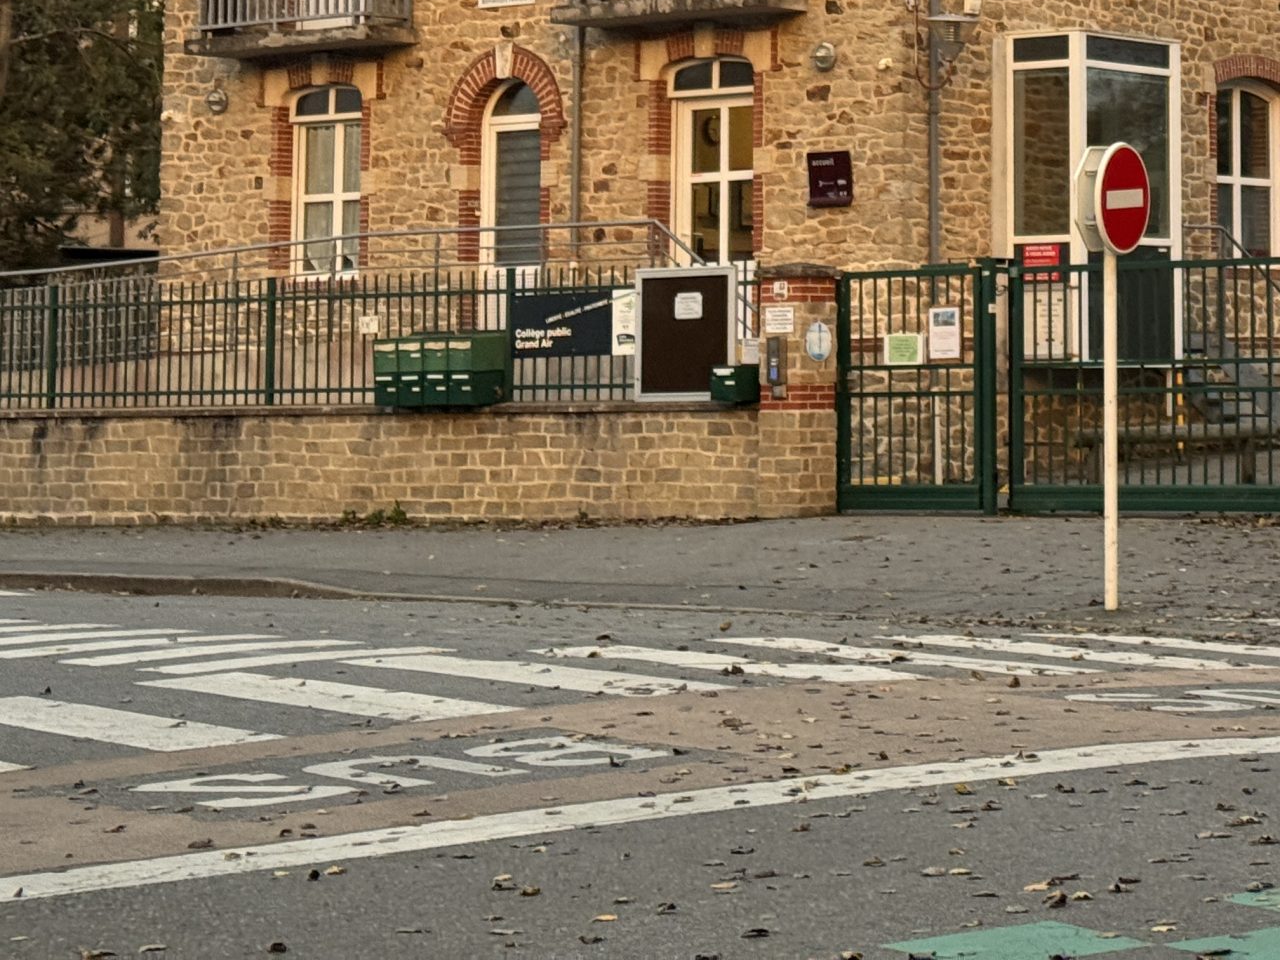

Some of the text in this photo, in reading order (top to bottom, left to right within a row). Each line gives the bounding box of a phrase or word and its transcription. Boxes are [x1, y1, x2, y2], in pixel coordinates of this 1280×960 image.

[515, 327, 572, 339] Collège public
[515, 338, 554, 350] Grand Air
[128, 736, 672, 808] BUS
